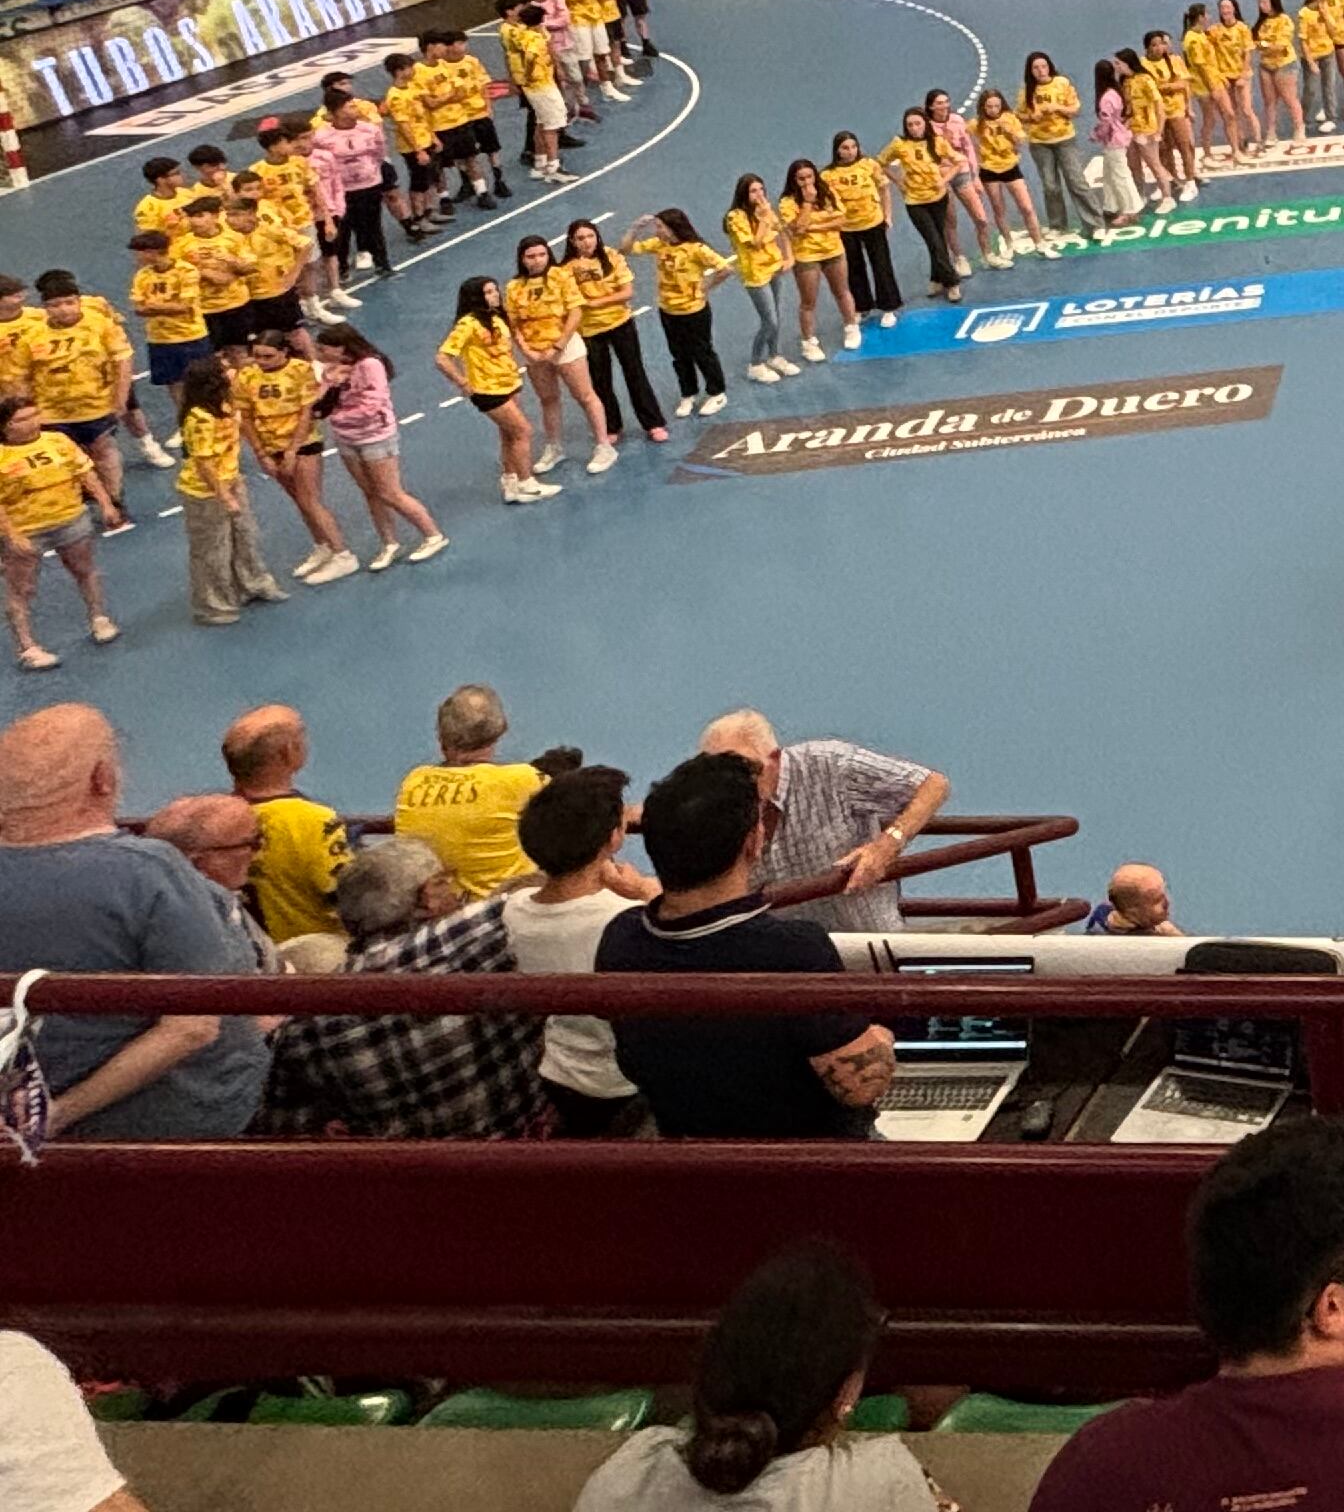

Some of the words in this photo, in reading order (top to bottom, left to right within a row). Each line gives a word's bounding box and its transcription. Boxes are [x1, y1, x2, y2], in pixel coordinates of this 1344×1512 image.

[31, 16, 214, 117] TUBOS
[1061, 282, 1268, 316] LOTERÍAS
[47, 336, 75, 354] 77
[713, 410, 979, 459] Aranda
[989, 406, 1034, 425] de
[1040, 381, 1256, 424] Duero
[24, 451, 53, 469] 15
[405, 780, 479, 808] CERES
